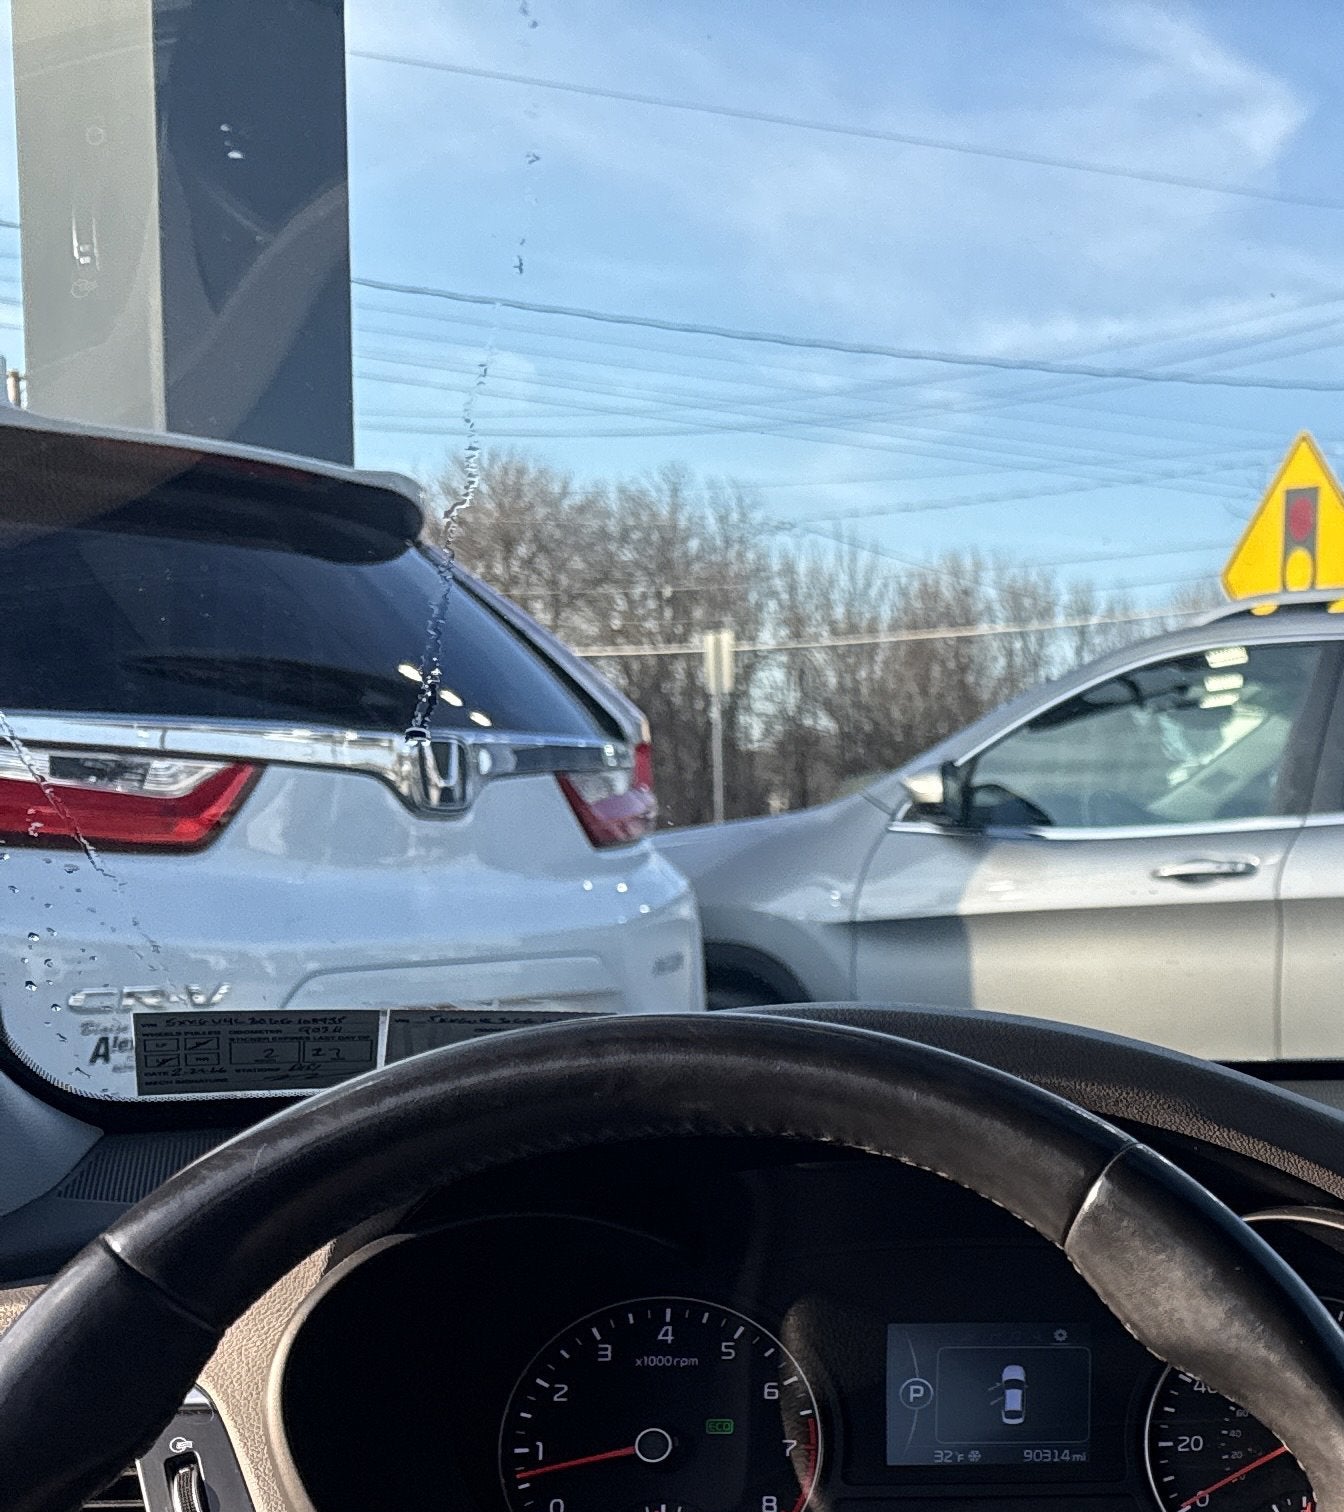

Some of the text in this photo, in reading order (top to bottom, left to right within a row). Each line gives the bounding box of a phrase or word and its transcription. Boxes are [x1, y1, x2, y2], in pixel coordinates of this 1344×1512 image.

[657, 1325, 675, 1344] 4
[597, 1344, 612, 1362] 3
[721, 1342, 736, 1360] 5
[553, 1384, 569, 1401] 2
[763, 1382, 779, 1400] 6
[909, 1386, 924, 1403] P
[535, 1441, 544, 1461] 1
[782, 1439, 798, 1457] 7
[1176, 1435, 1204, 1452] 20
[1023, 1450, 1071, 1463] 90314
